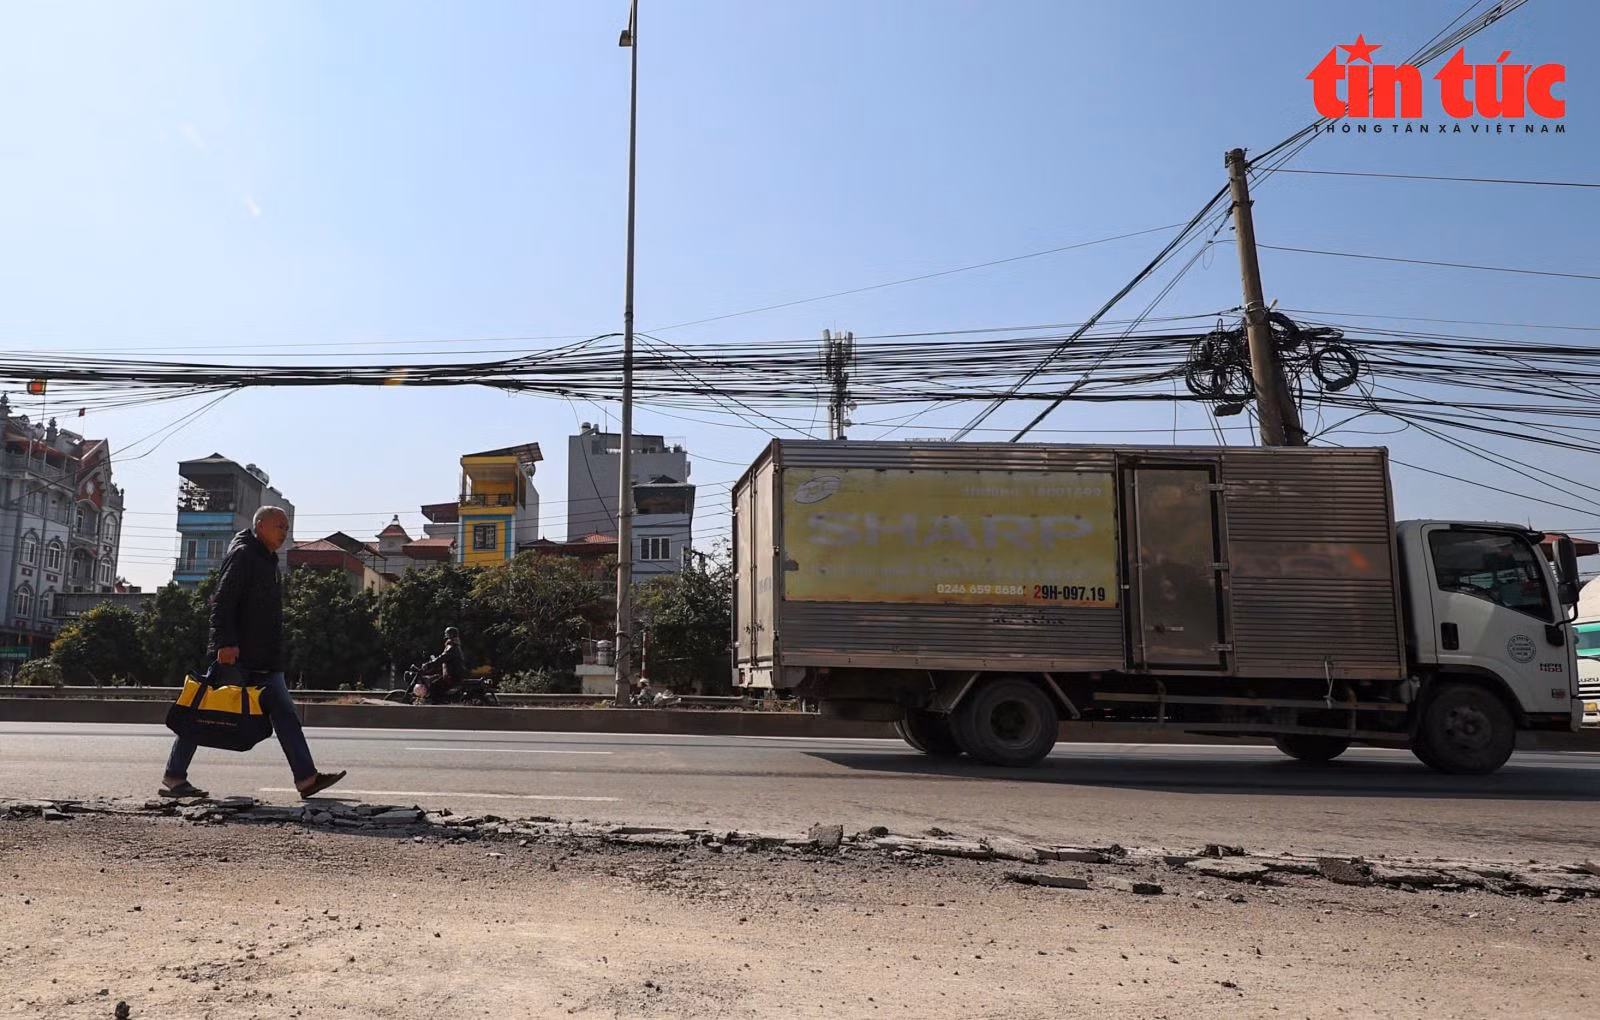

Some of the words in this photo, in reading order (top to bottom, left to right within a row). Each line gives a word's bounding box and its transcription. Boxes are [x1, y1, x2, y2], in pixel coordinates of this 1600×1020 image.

[808, 512, 1094, 550] SHARP
[936, 584, 966, 594] 0246
[969, 584, 992, 595] 659
[1033, 585, 1105, 601] 29H-097.19
